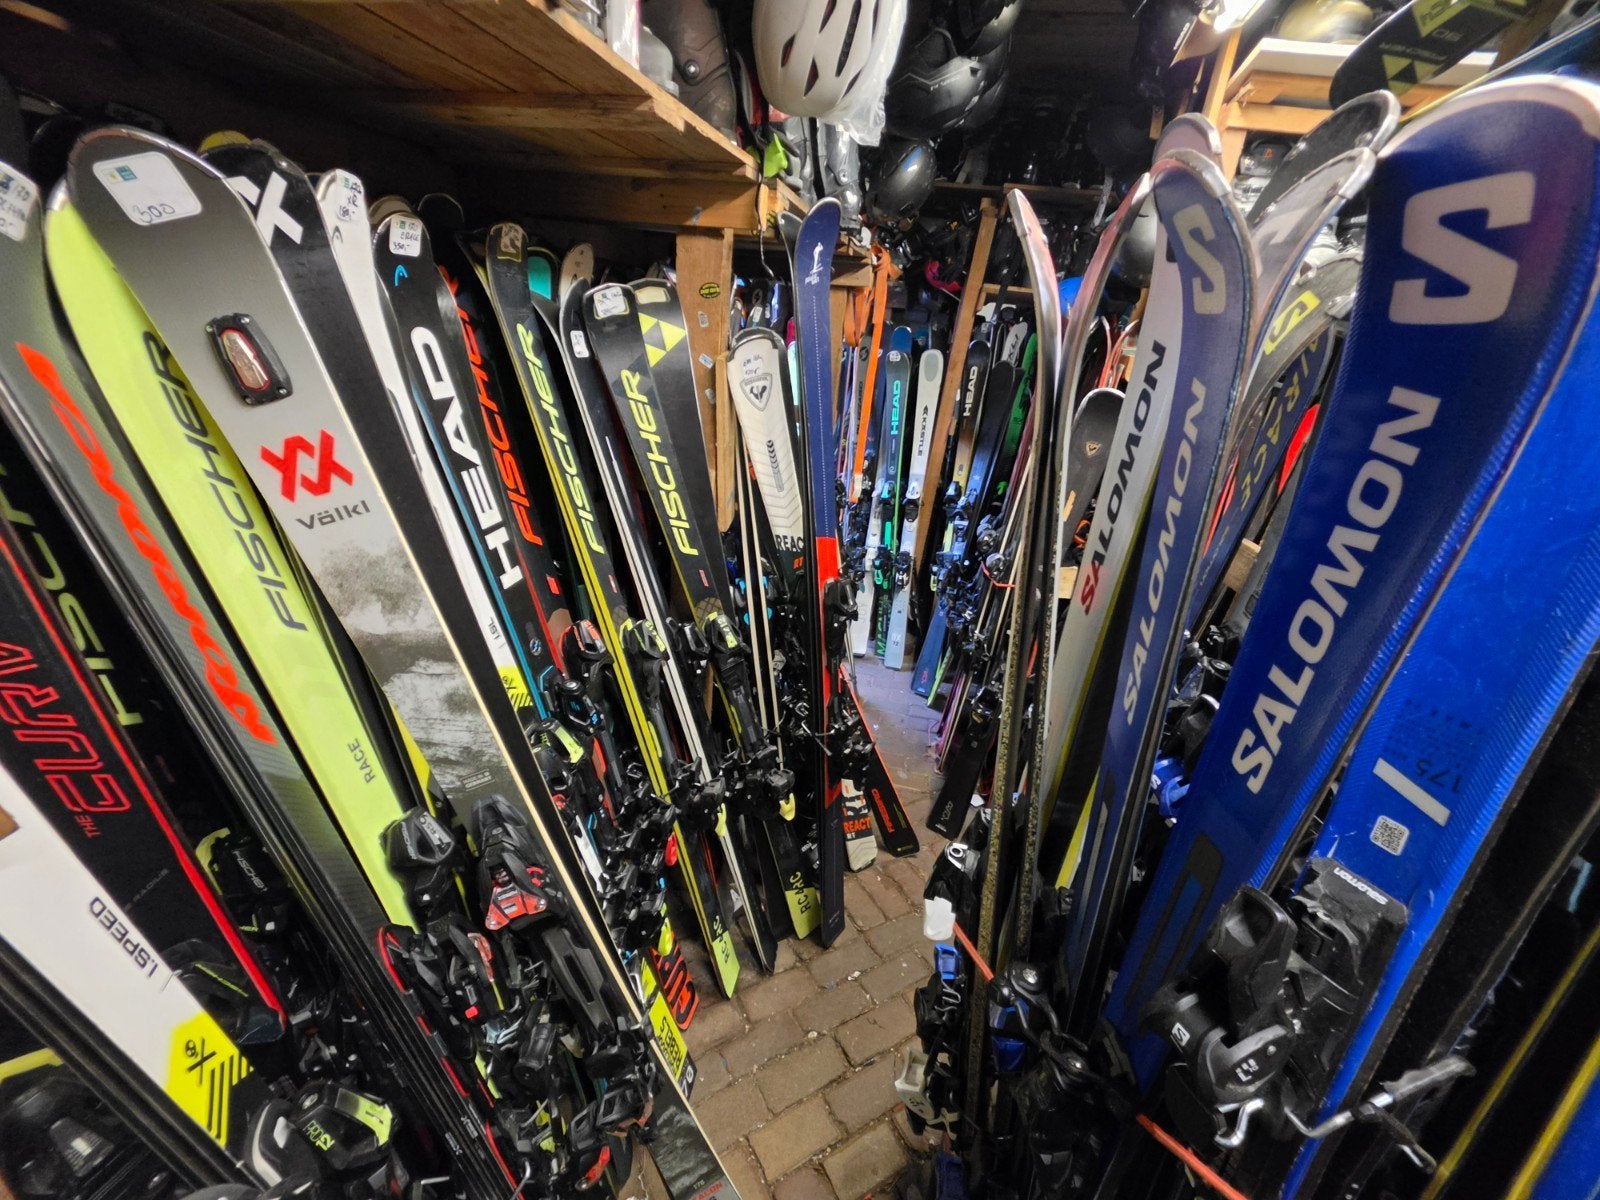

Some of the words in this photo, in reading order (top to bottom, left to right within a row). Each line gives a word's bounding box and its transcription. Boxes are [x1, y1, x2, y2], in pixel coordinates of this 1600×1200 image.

[133, 203, 176, 224] 300
[143, 331, 309, 632] FISCHER
[411, 327, 523, 590] HEAD
[517, 323, 605, 554] FISCHER
[620, 369, 699, 556] FISCHER
[890, 380, 901, 435] HEAD
[963, 366, 978, 417] HEAD
[1080, 340, 1166, 616] SALOMON
[0, 461, 143, 727] FISCH
[16, 341, 278, 746] NORDICA
[1123, 377, 1206, 725] SALOMON
[1231, 386, 1441, 795] SALOMON
[75, 814, 101, 838] THE
[348, 738, 374, 784] RACE
[843, 816, 871, 833] REACT
[659, 1016, 681, 1067] REBELS
